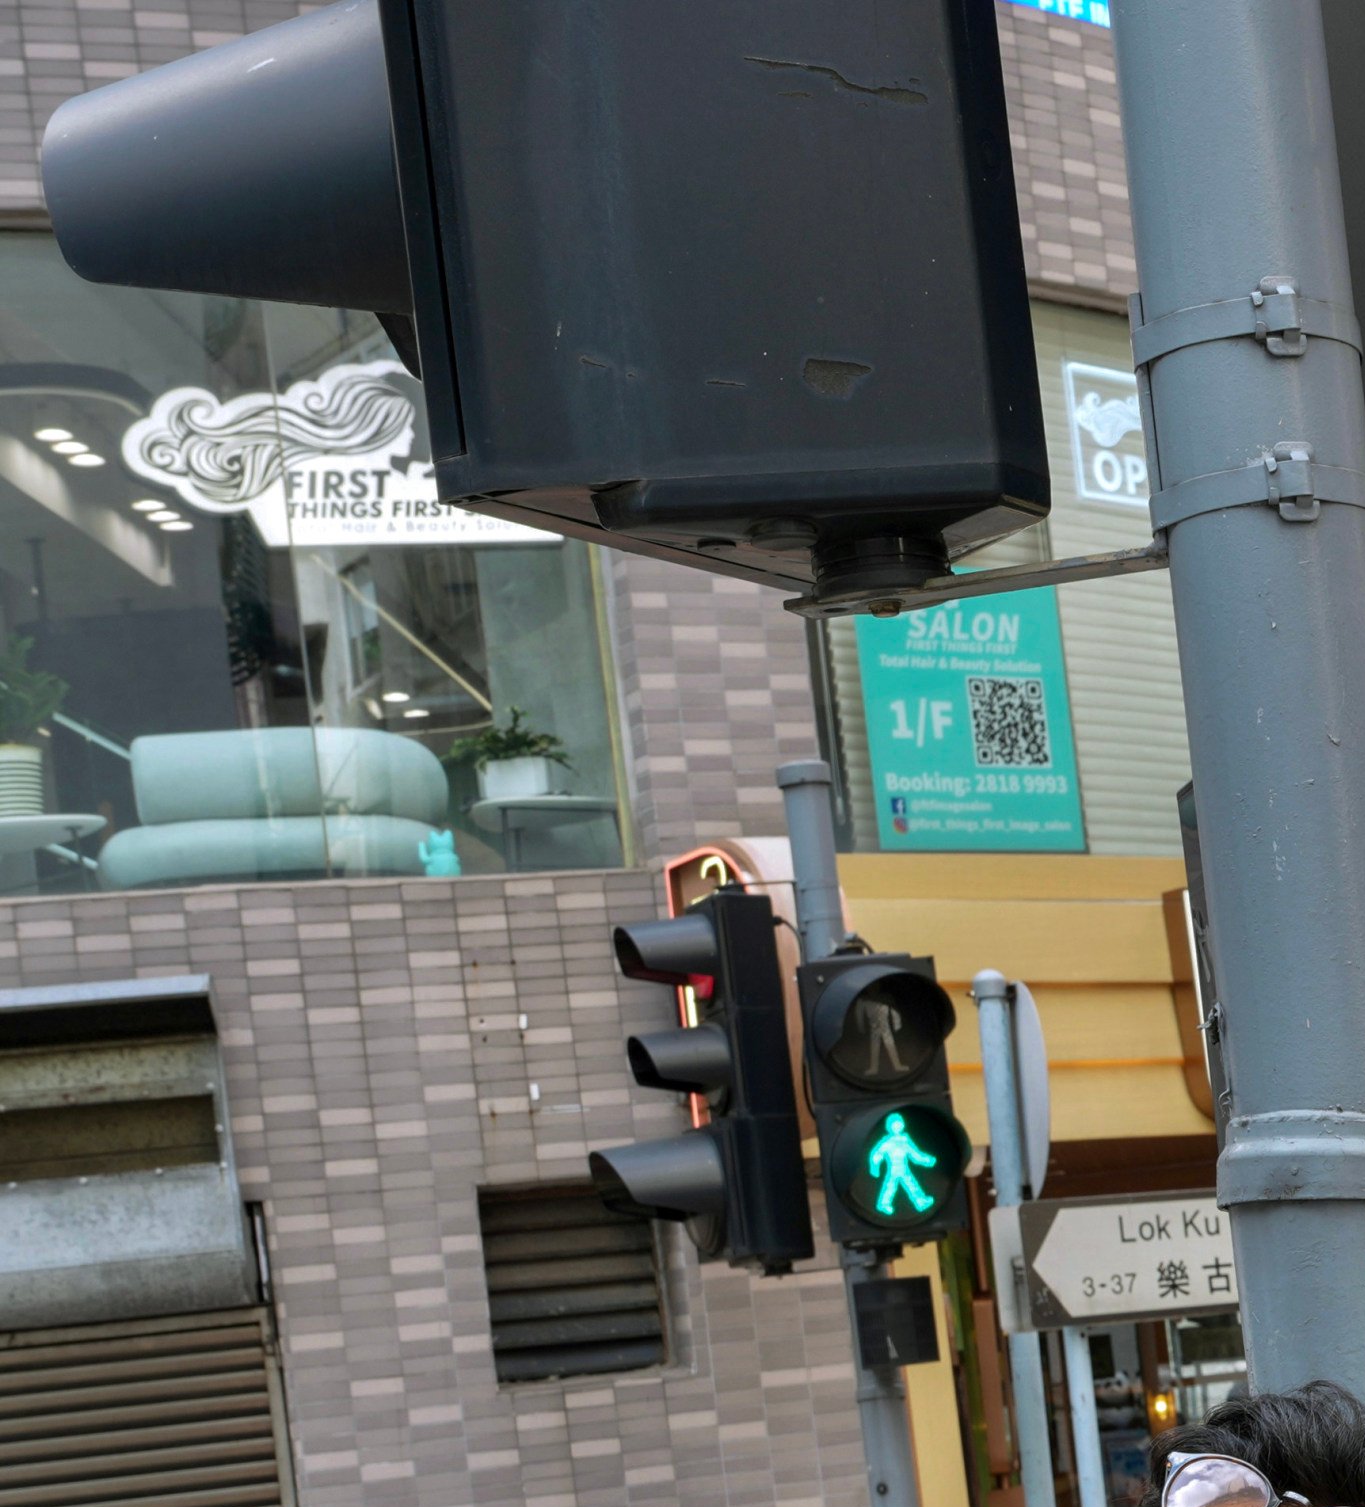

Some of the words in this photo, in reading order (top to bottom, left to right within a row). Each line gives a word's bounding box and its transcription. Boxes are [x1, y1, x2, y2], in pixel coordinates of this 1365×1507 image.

[287, 470, 391, 500] FIRST
[1092, 449, 1149, 495] OP
[289, 500, 382, 519] THINGS
[908, 611, 1020, 641] SALON
[906, 639, 938, 651] FIRST
[941, 641, 984, 654] THINGS
[985, 643, 1018, 655] FIRST
[879, 653, 909, 668] Total
[911, 655, 937, 669] Hair
[938, 657, 947, 669] &
[950, 657, 991, 673] Beauty
[994, 659, 1042, 673] Solution
[890, 697, 953, 748] 1/F
[885, 772, 971, 797] Booking:
[975, 774, 1021, 793] 2818
[1024, 775, 1068, 794] 9993
[1118, 1214, 1171, 1243] Lok
[1182, 1209, 1221, 1238] Ku
[1082, 1273, 1137, 1298] 3-37
[1157, 1257, 1233, 1299] 樂古
